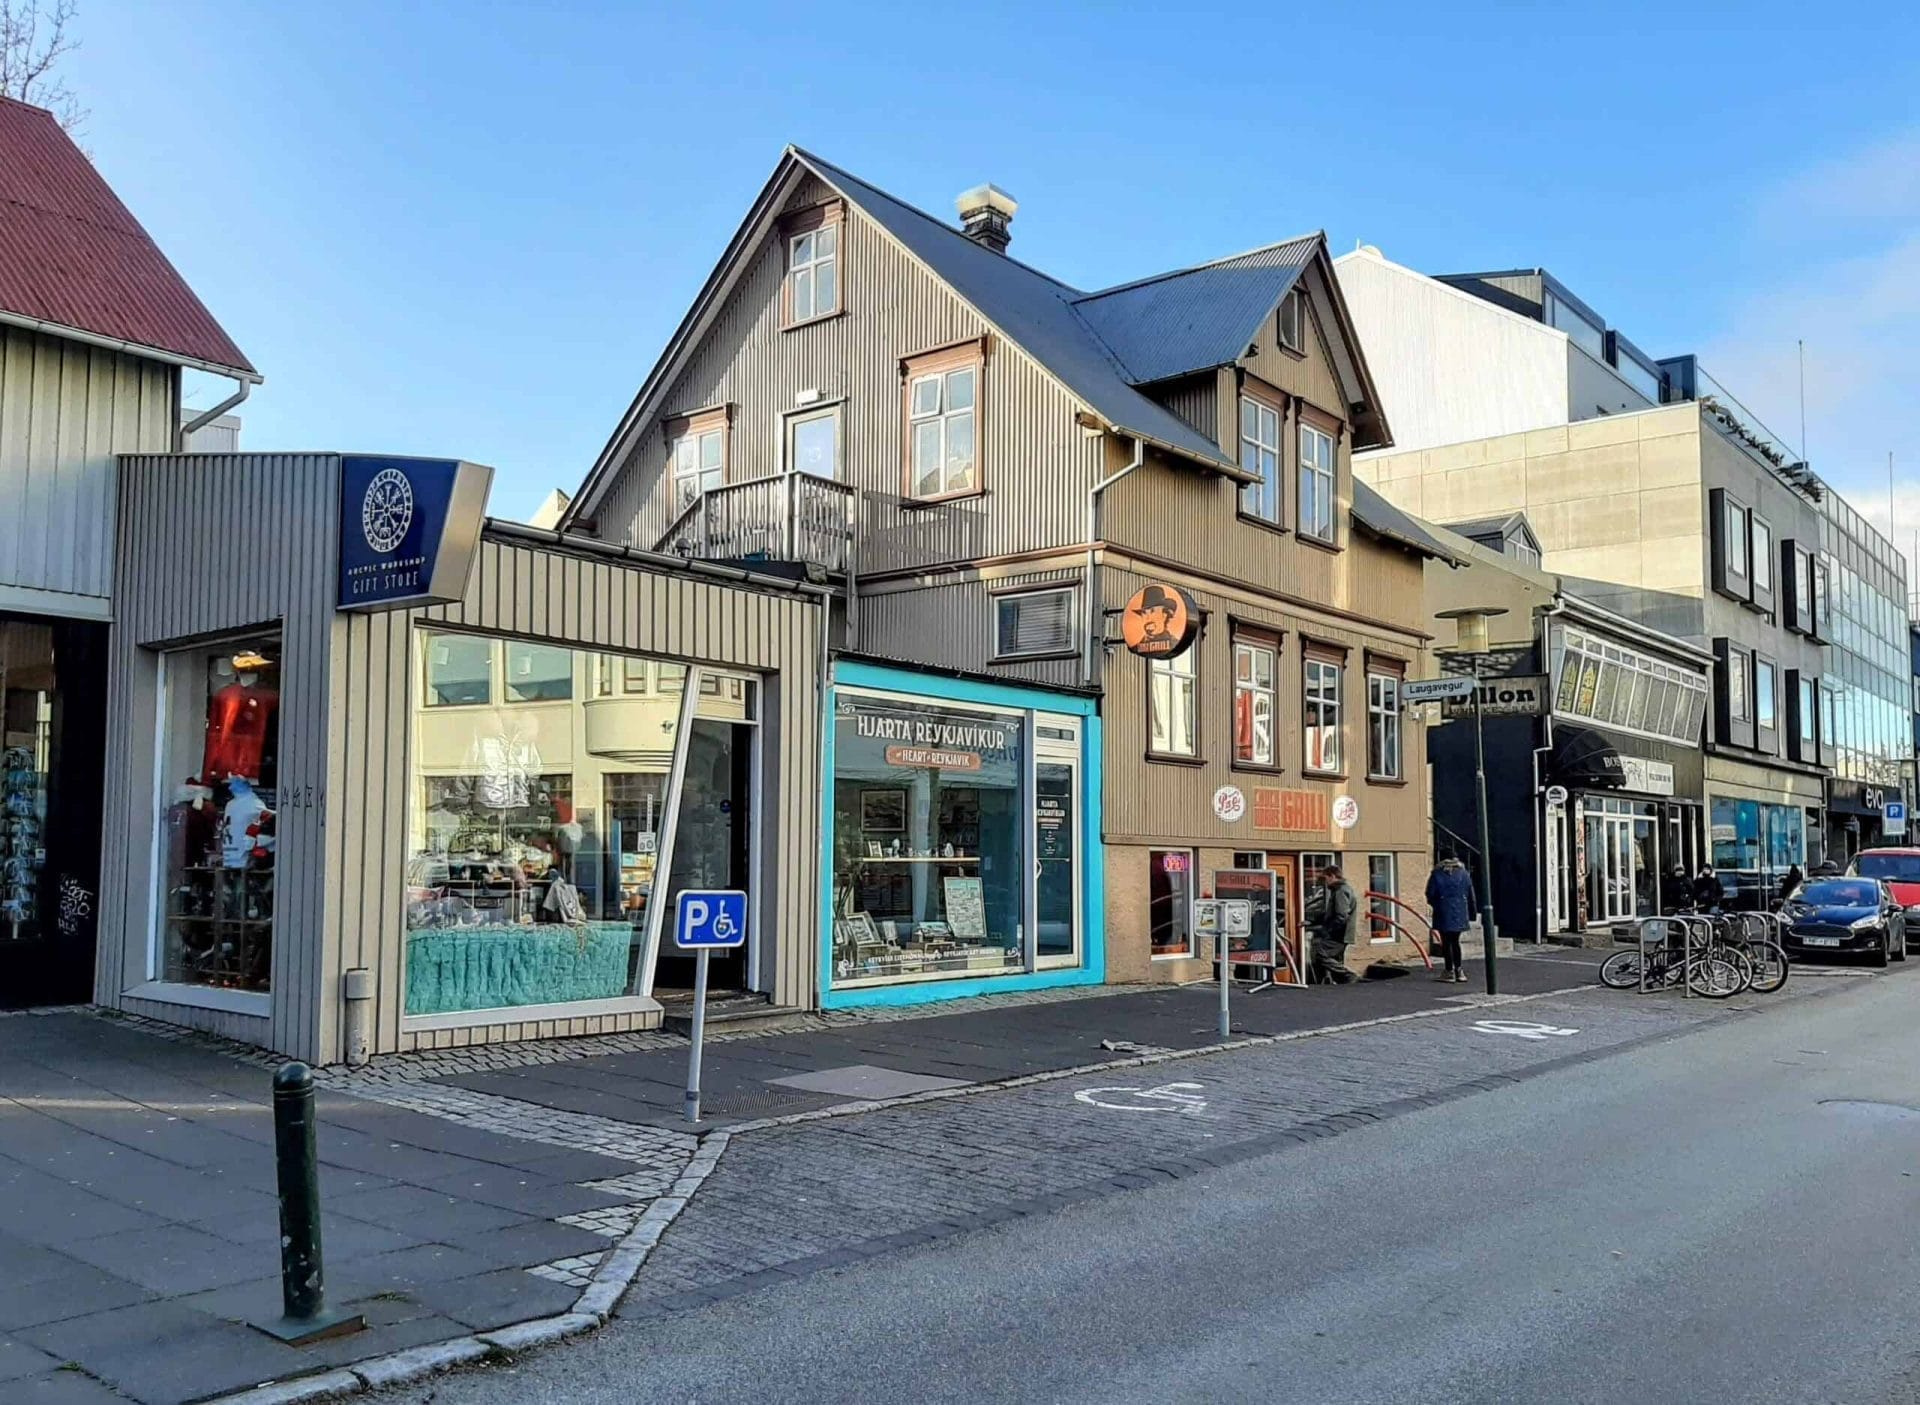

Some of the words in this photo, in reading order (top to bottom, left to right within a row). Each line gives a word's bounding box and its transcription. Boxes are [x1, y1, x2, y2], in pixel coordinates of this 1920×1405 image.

[353, 577, 378, 594] GIFT
[384, 571, 418, 590] STORE
[1409, 681, 1464, 695] Laugavegur
[857, 715, 912, 741] HJARTA
[916, 721, 1005, 750] REYKJAVÍKUR
[902, 749, 927, 763] HEART
[931, 752, 970, 767] REYKJAVIK
[1281, 790, 1327, 830] GRILL
[684, 900, 709, 940] P
